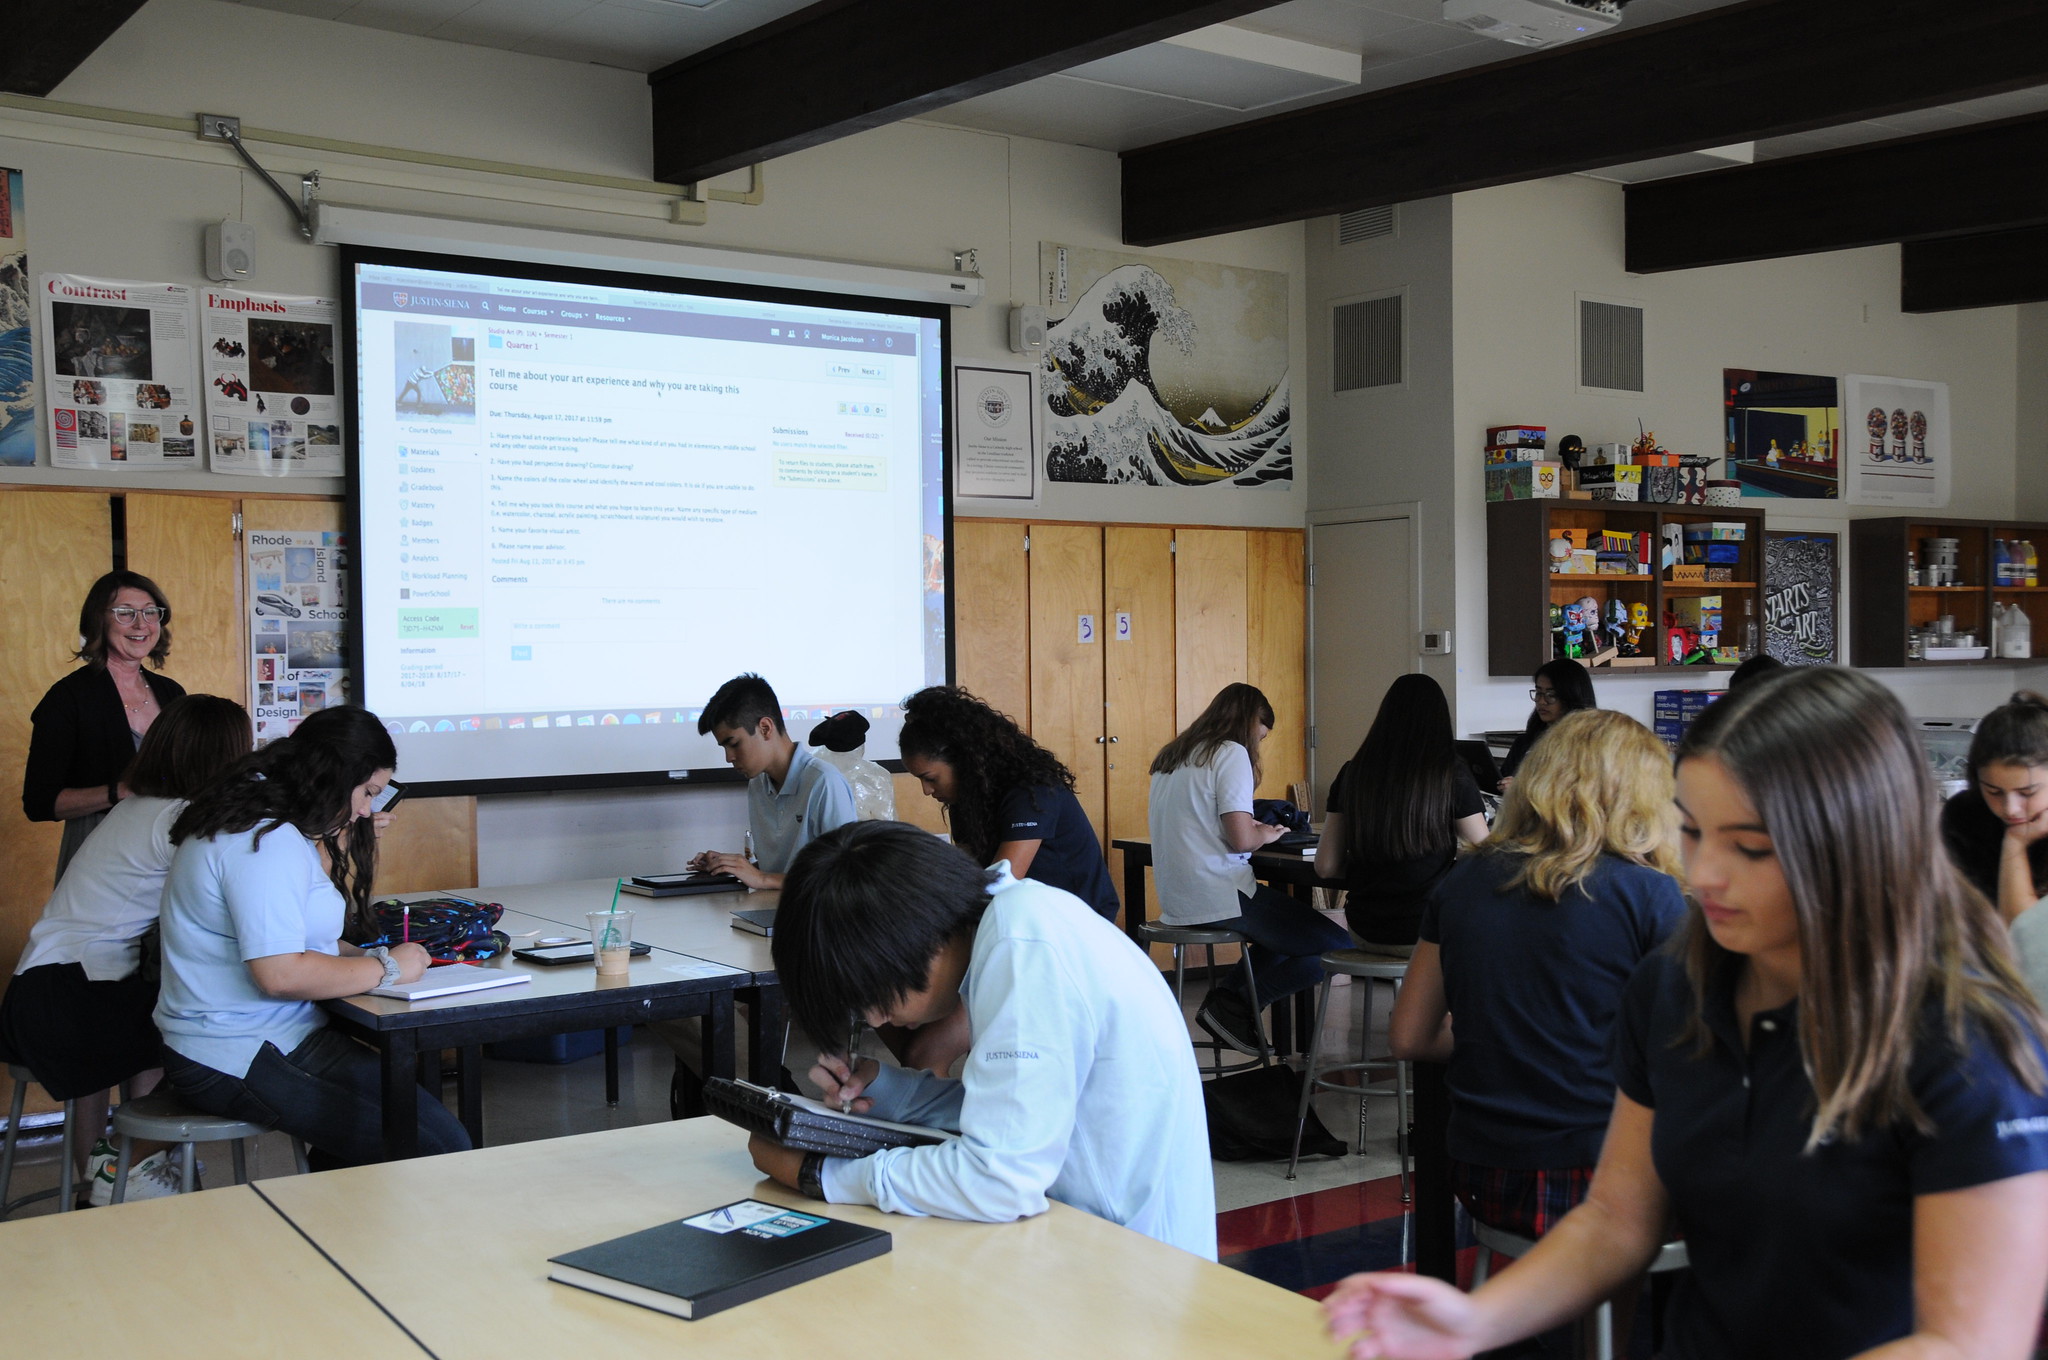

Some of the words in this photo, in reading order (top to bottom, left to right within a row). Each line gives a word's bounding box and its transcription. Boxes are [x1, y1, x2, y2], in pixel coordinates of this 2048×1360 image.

[48, 280, 127, 300] Contrast
[208, 293, 287, 313] Emphasis
[410, 294, 470, 311] JUSTIN-SIENA
[498, 304, 516, 313] Home
[523, 306, 548, 316] Courses
[561, 310, 582, 319] Groups
[596, 313, 625, 322] Resources
[506, 340, 533, 350] Quarter
[535, 343, 539, 351] 1
[838, 366, 850, 374] Prev
[489, 368, 505, 378] Tell
[508, 371, 520, 380] me
[523, 371, 548, 381] about
[550, 374, 569, 383] your
[572, 375, 584, 384] art
[586, 376, 630, 387] experience
[632, 378, 647, 388] and
[649, 379, 666, 390] why
[667, 382, 682, 392] you
[684, 383, 697, 391] are
[699, 383, 723, 395] taking
[725, 384, 740, 394] this
[489, 382, 518, 392] course
[772, 426, 809, 437] Submissions
[410, 448, 440, 456] Materials
[252, 534, 293, 546] Rhode
[316, 548, 327, 583] Island
[492, 575, 528, 584] Comments
[308, 609, 350, 620] School
[1080, 617, 1092, 639] 3
[1120, 616, 1128, 634] 5
[287, 670, 300, 681] of
[256, 708, 298, 720] Design
[985, 1051, 1039, 1062] JUSTIN-SIENA
